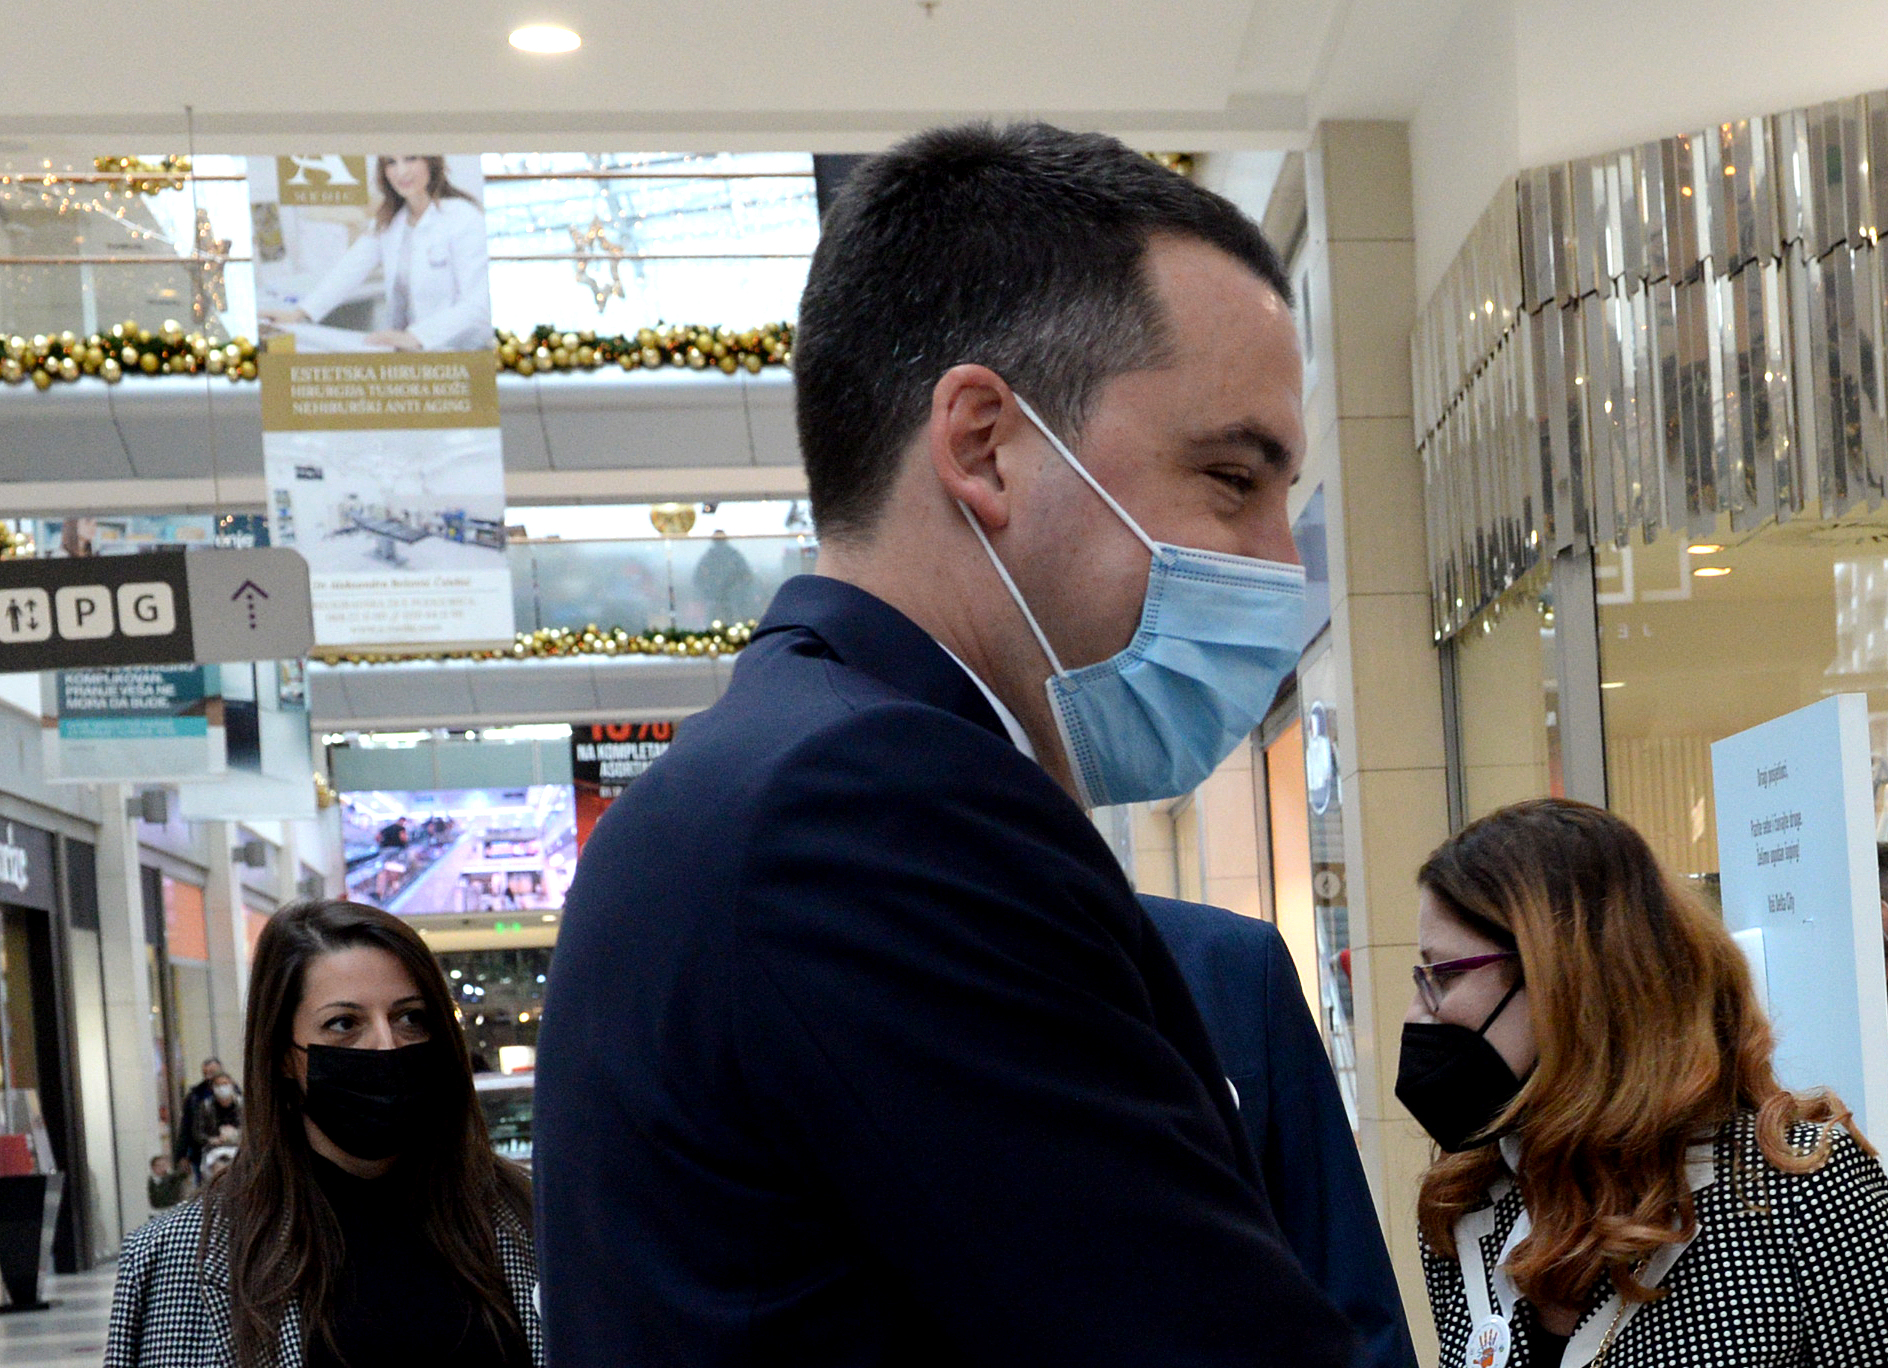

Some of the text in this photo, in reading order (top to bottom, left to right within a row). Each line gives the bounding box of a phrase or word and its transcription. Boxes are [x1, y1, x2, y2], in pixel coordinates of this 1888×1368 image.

[290, 364, 470, 382] ESTETSKA HIRURGIJA
[385, 399, 422, 413] ANTI
[75, 594, 159, 628] P G
[156, 681, 177, 696] NE
[109, 697, 130, 709] DA
[576, 743, 597, 761] NA
